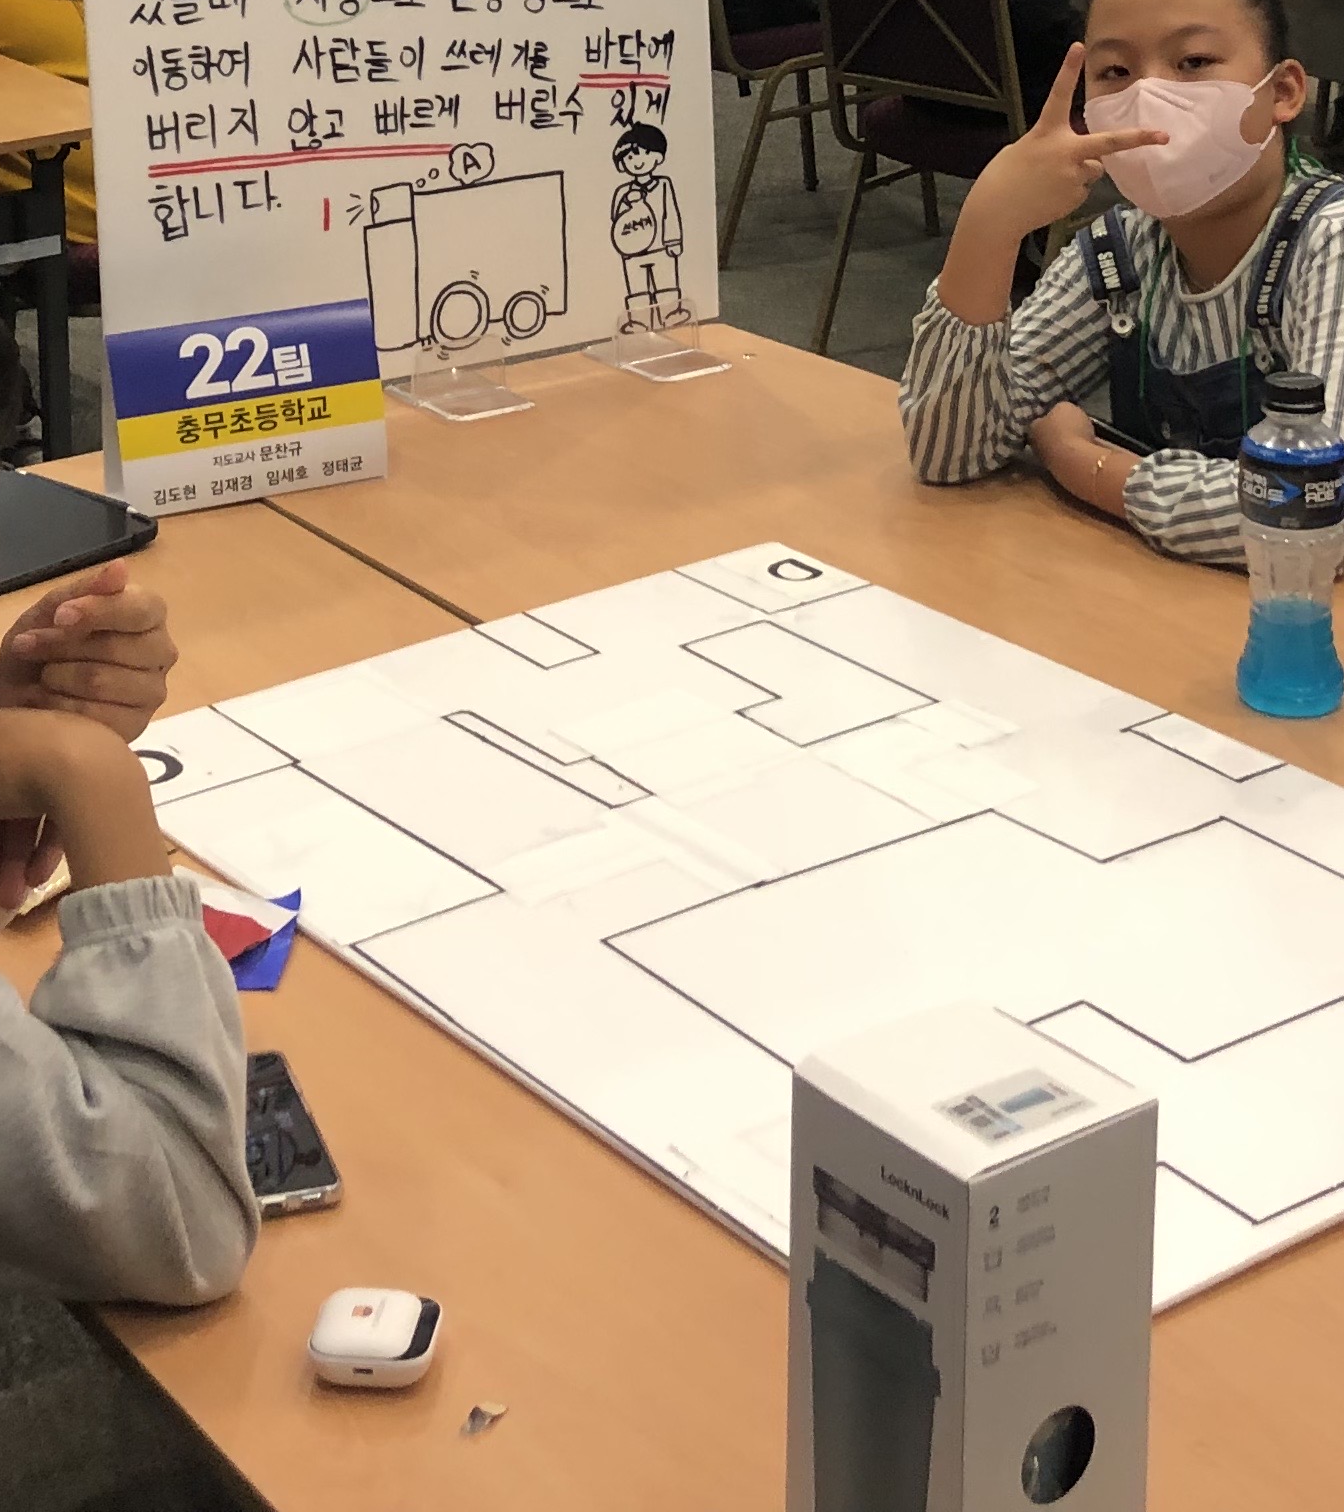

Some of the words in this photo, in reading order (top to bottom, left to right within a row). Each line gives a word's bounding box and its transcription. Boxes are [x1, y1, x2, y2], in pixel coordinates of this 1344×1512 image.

[132, 41, 251, 95] 이동하여
[292, 35, 426, 83] 사람들이
[584, 29, 675, 75] 바닥에
[147, 100, 259, 154] 버리지
[287, 102, 346, 151] 않고
[374, 90, 460, 136] 빠르게
[609, 80, 672, 128] 있게
[462, 151, 482, 175] A
[147, 170, 283, 242] 합니다.
[178, 326, 313, 400] 22팀
[175, 395, 332, 445] 충무초등학교
[153, 484, 197, 506] 김도현
[210, 475, 253, 496] 김재경
[266, 465, 309, 486] 임세호
[322, 456, 364, 476] 정태균
[212, 450, 256, 468] 지도교사
[259, 441, 303, 462] 문찬규
[880, 1164, 950, 1221] LocknLock
